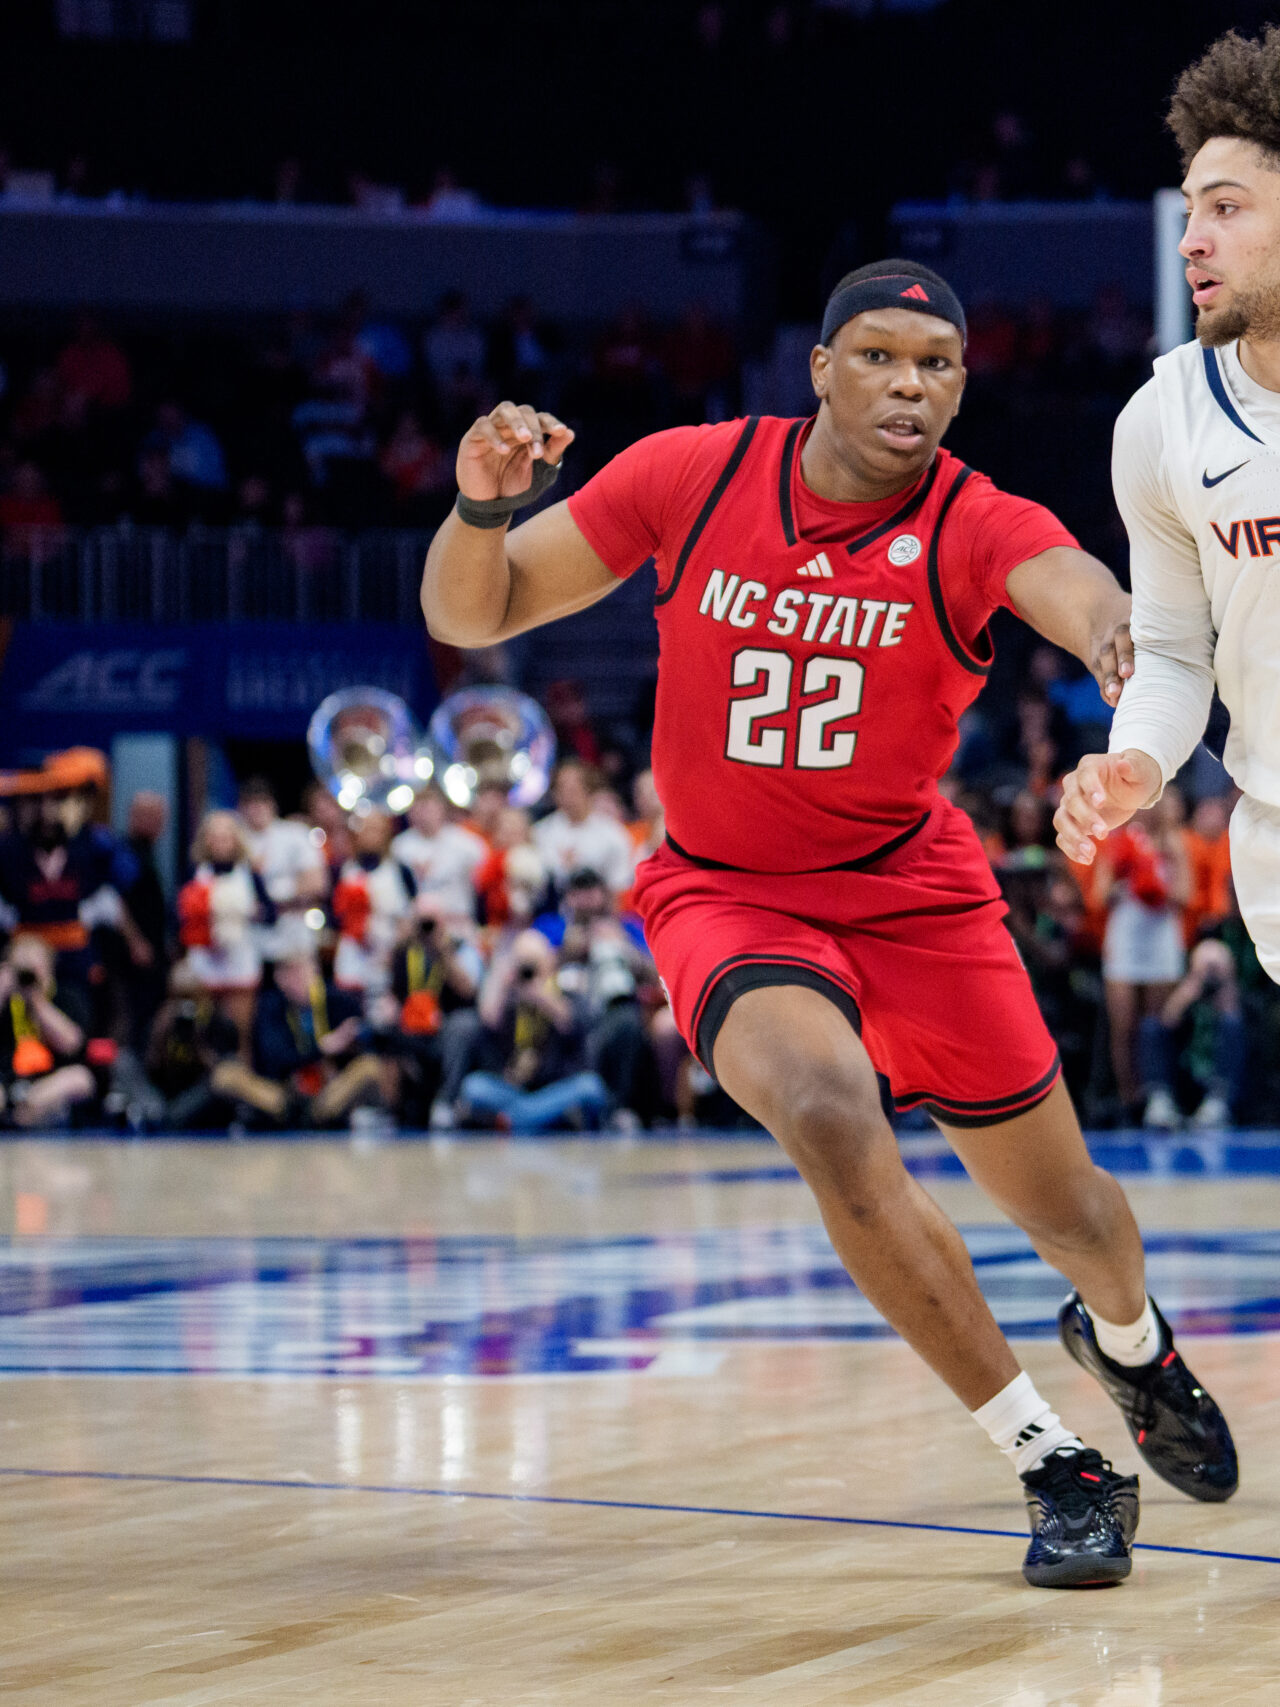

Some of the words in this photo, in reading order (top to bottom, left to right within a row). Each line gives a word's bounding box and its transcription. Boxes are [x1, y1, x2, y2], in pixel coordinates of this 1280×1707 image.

[698, 568, 768, 629] NC
[766, 588, 915, 648] STATE
[724, 646, 865, 770] 22
